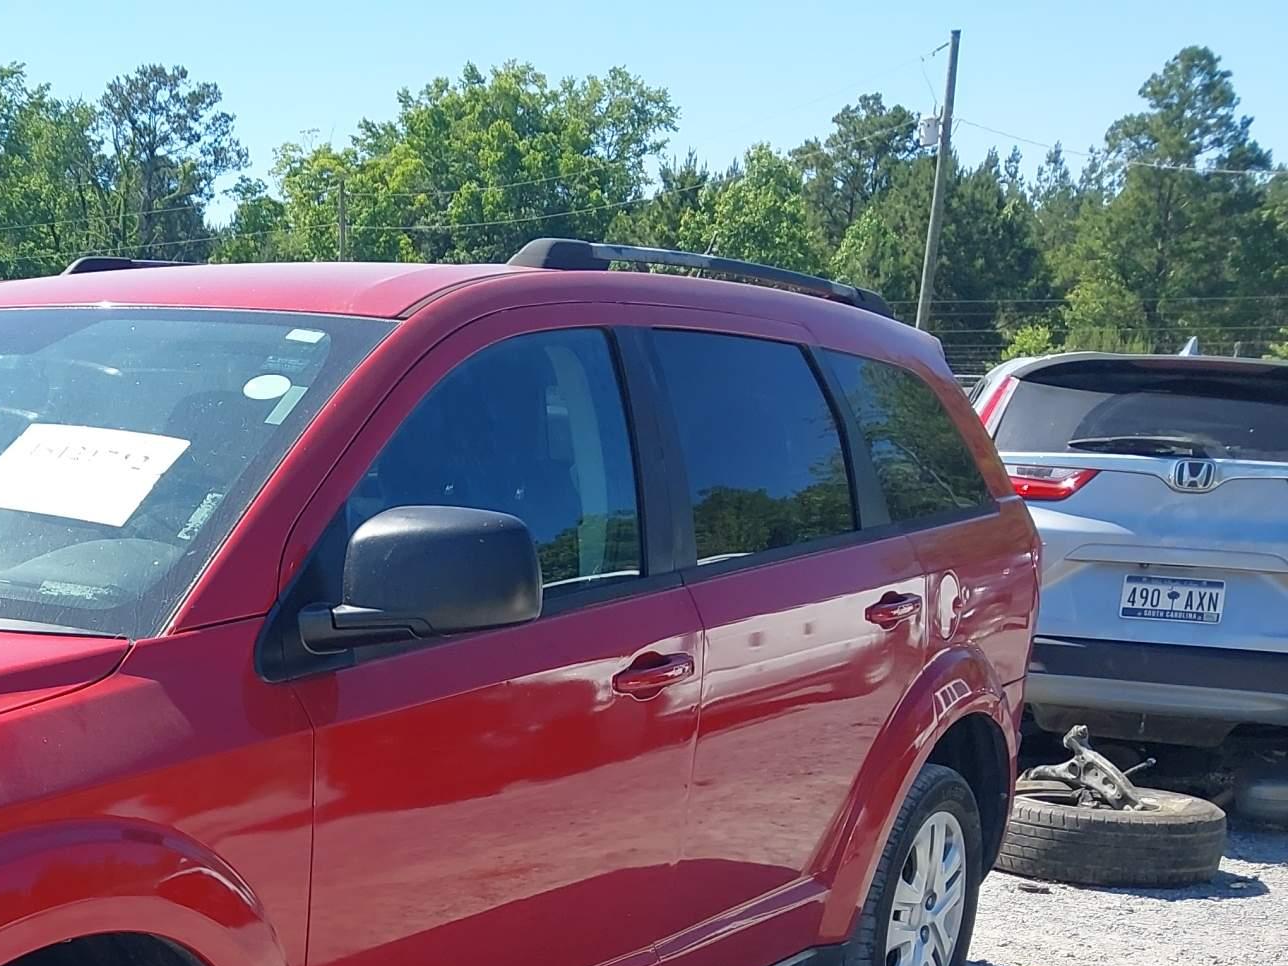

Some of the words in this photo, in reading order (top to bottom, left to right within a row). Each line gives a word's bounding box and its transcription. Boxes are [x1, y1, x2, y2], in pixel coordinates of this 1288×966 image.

[1127, 587, 1161, 608] 490
[1184, 590, 1220, 612] AXN
[1143, 609, 1162, 617] SOUTH
[1165, 611, 1198, 620] CAROLINA
